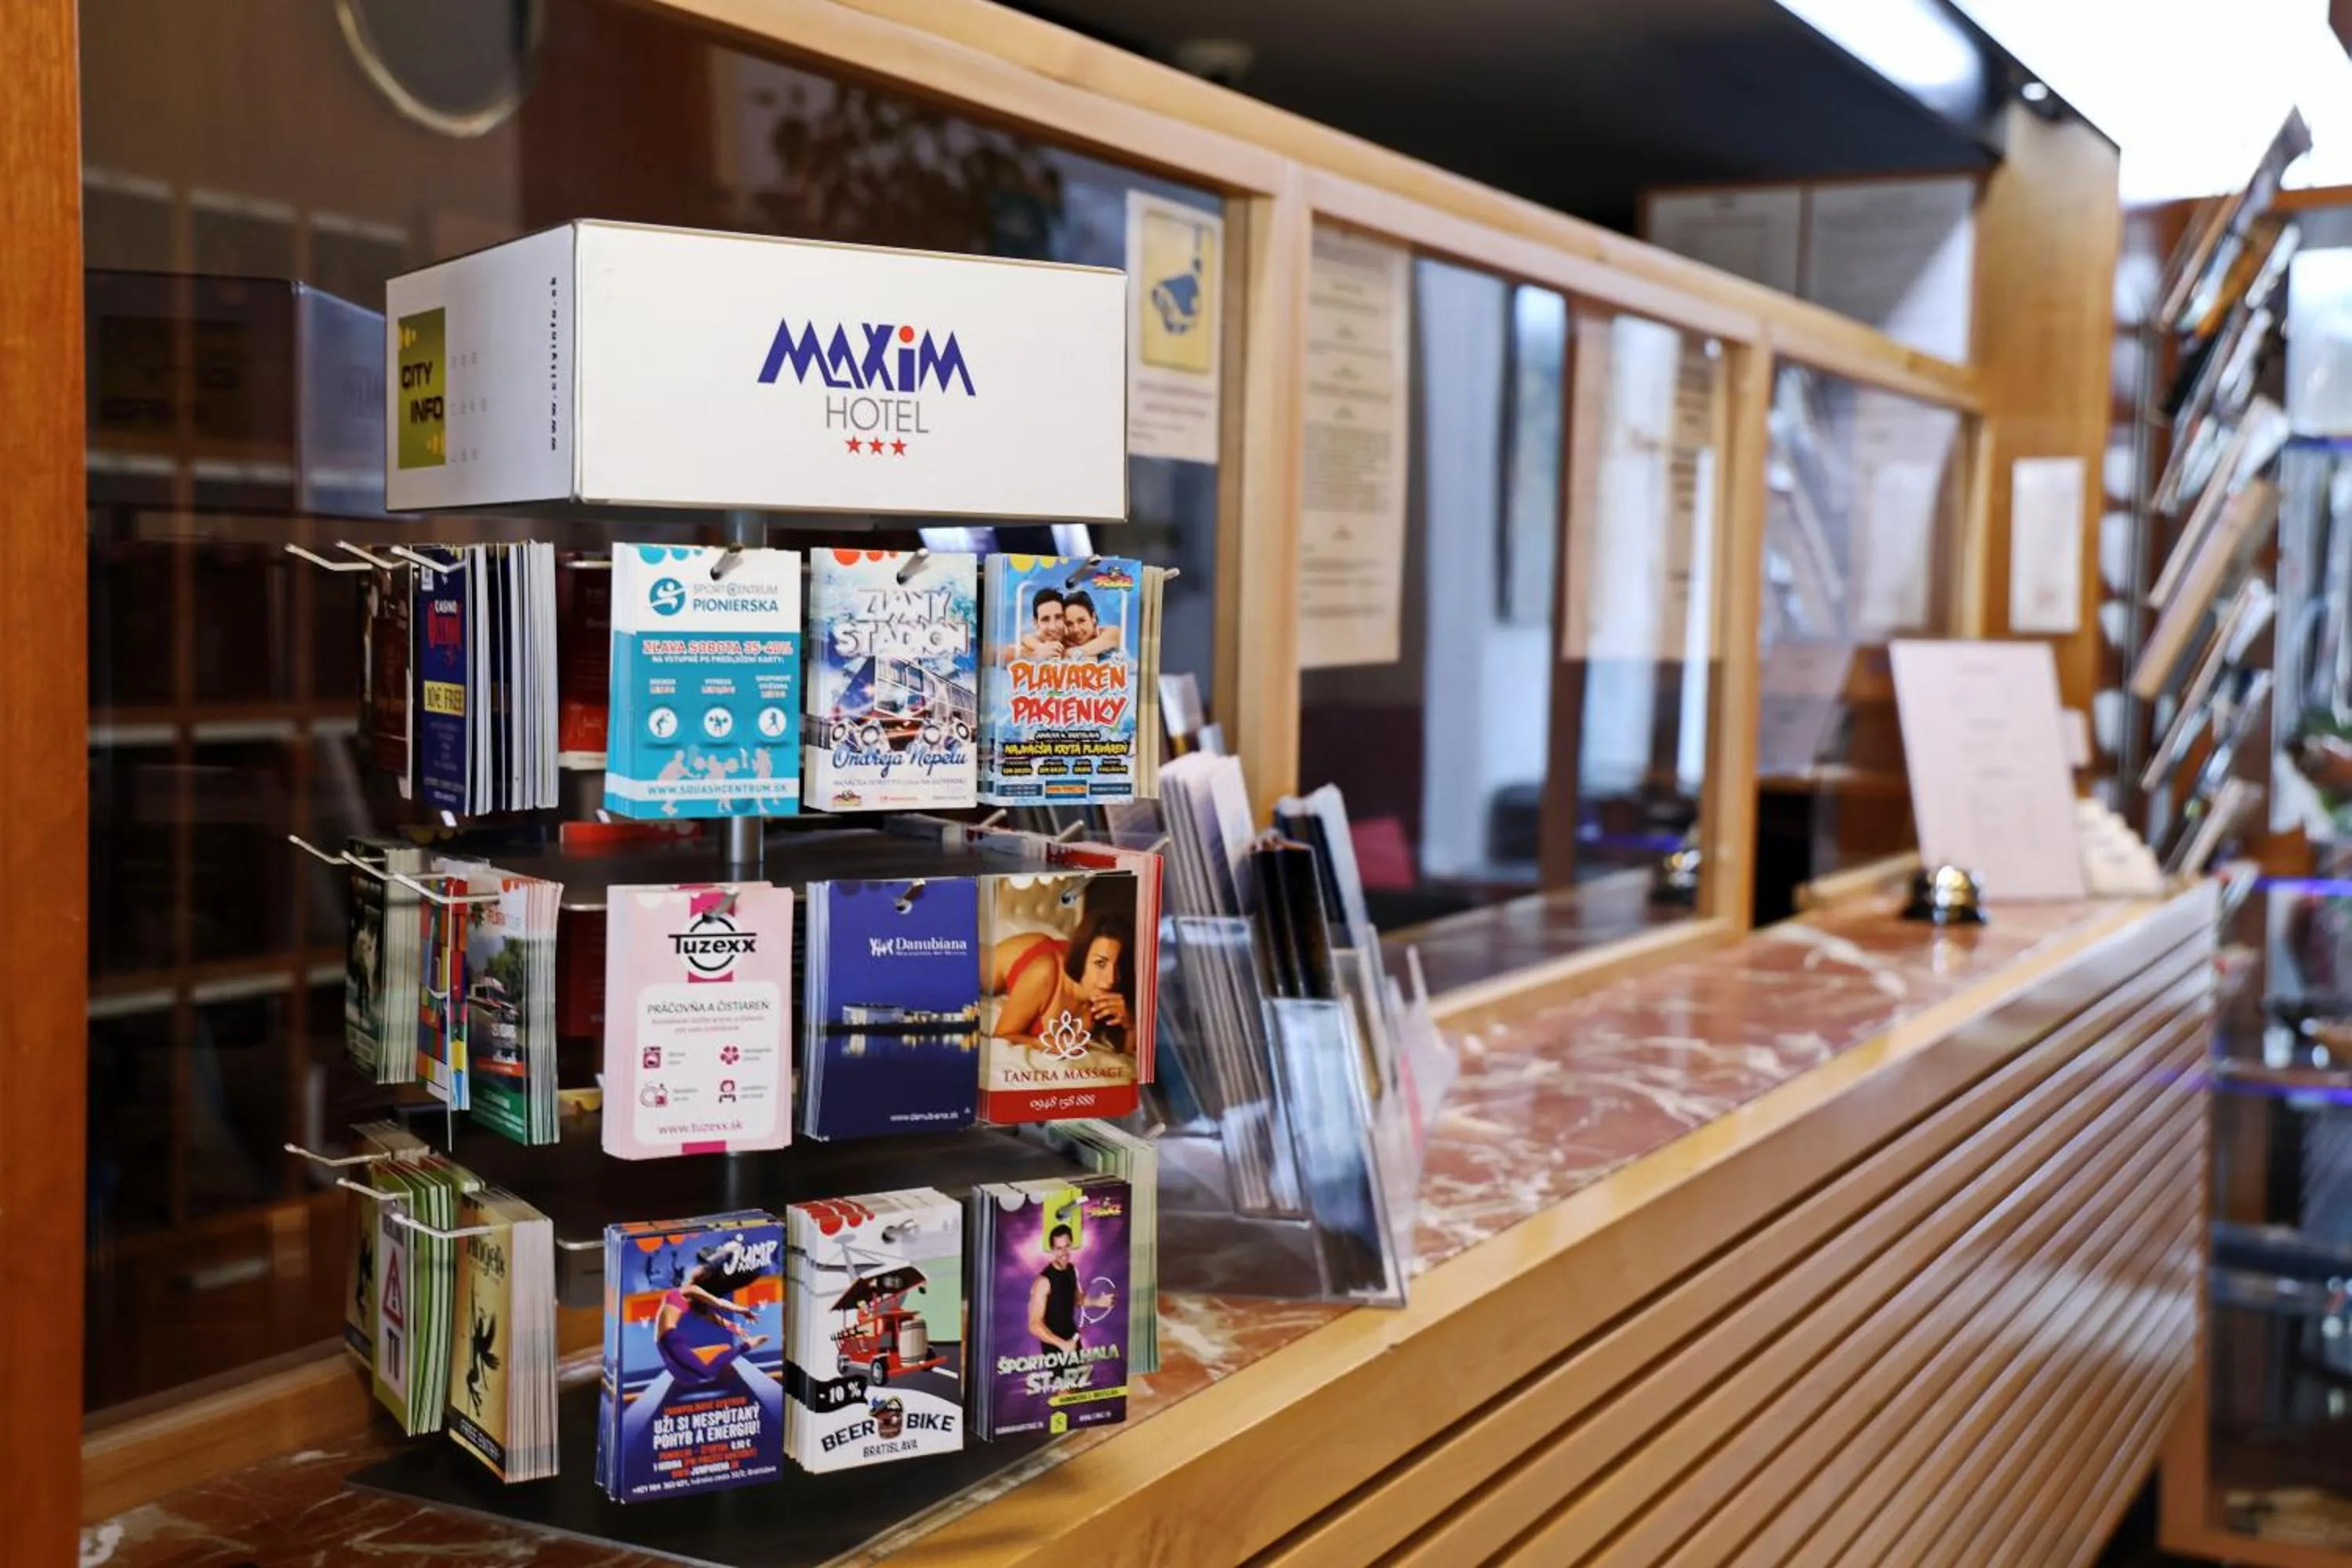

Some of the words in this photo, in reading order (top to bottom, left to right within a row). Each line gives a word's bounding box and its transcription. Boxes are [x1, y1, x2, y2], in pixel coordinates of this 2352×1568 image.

[401, 361, 434, 390] CITY
[410, 396, 445, 424] INFO
[826, 394, 930, 434] HOTEL
[692, 598, 779, 613] PIONIERSKA
[895, 937, 967, 951] Danubiana
[1003, 1069, 1059, 1083] TANTRA
[1062, 1066, 1124, 1080] MASSAGE
[658, 1119, 743, 1135] www.tuzexx.sk
[677, 1415, 690, 1430] SI
[653, 1430, 694, 1450] POHYB
[695, 1430, 705, 1443] A
[707, 1421, 761, 1441] ENERGIU!
[821, 1420, 875, 1453] BEER
[906, 1412, 956, 1432] BIKE
[862, 1439, 918, 1458] BRATISLAVA
